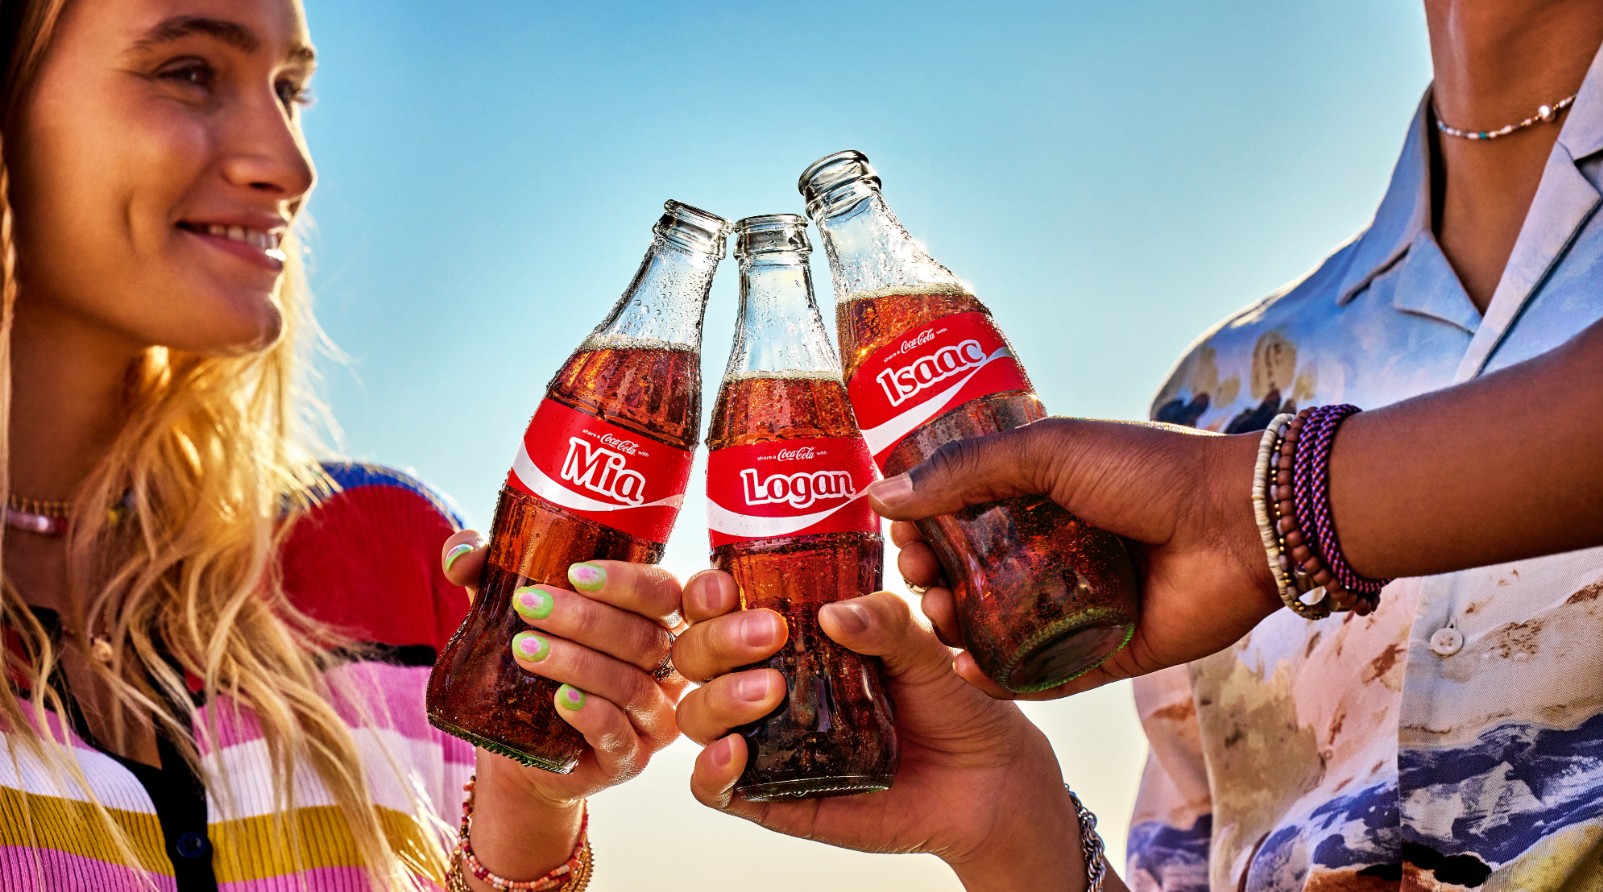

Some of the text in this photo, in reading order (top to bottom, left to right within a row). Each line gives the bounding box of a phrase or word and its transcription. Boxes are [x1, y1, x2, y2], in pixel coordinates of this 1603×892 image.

[900, 328, 936, 354] Coca-Cola
[876, 339, 986, 407] Isaac
[600, 433, 640, 456] Coca-Cola
[777, 446, 816, 462] Coca-Cola
[560, 436, 646, 506] Mia
[739, 468, 857, 509] Logan
